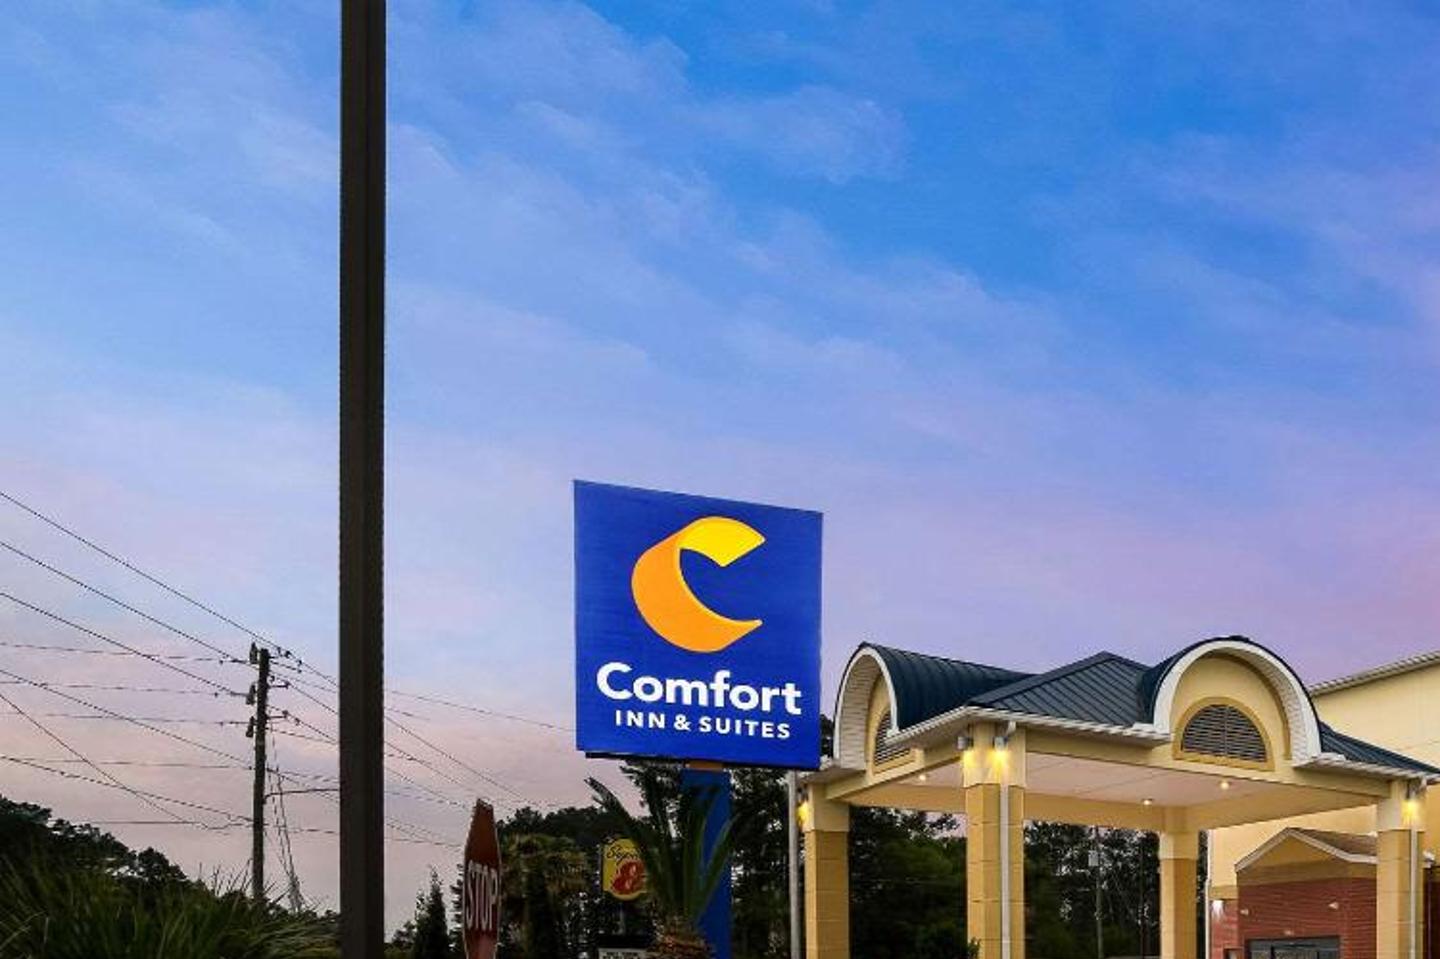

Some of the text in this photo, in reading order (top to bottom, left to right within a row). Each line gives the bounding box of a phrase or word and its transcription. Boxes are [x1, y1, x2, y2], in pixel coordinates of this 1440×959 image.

[596, 661, 802, 716] Comfort
[615, 709, 791, 739] INN & SUITES
[466, 859, 499, 931] STOP
